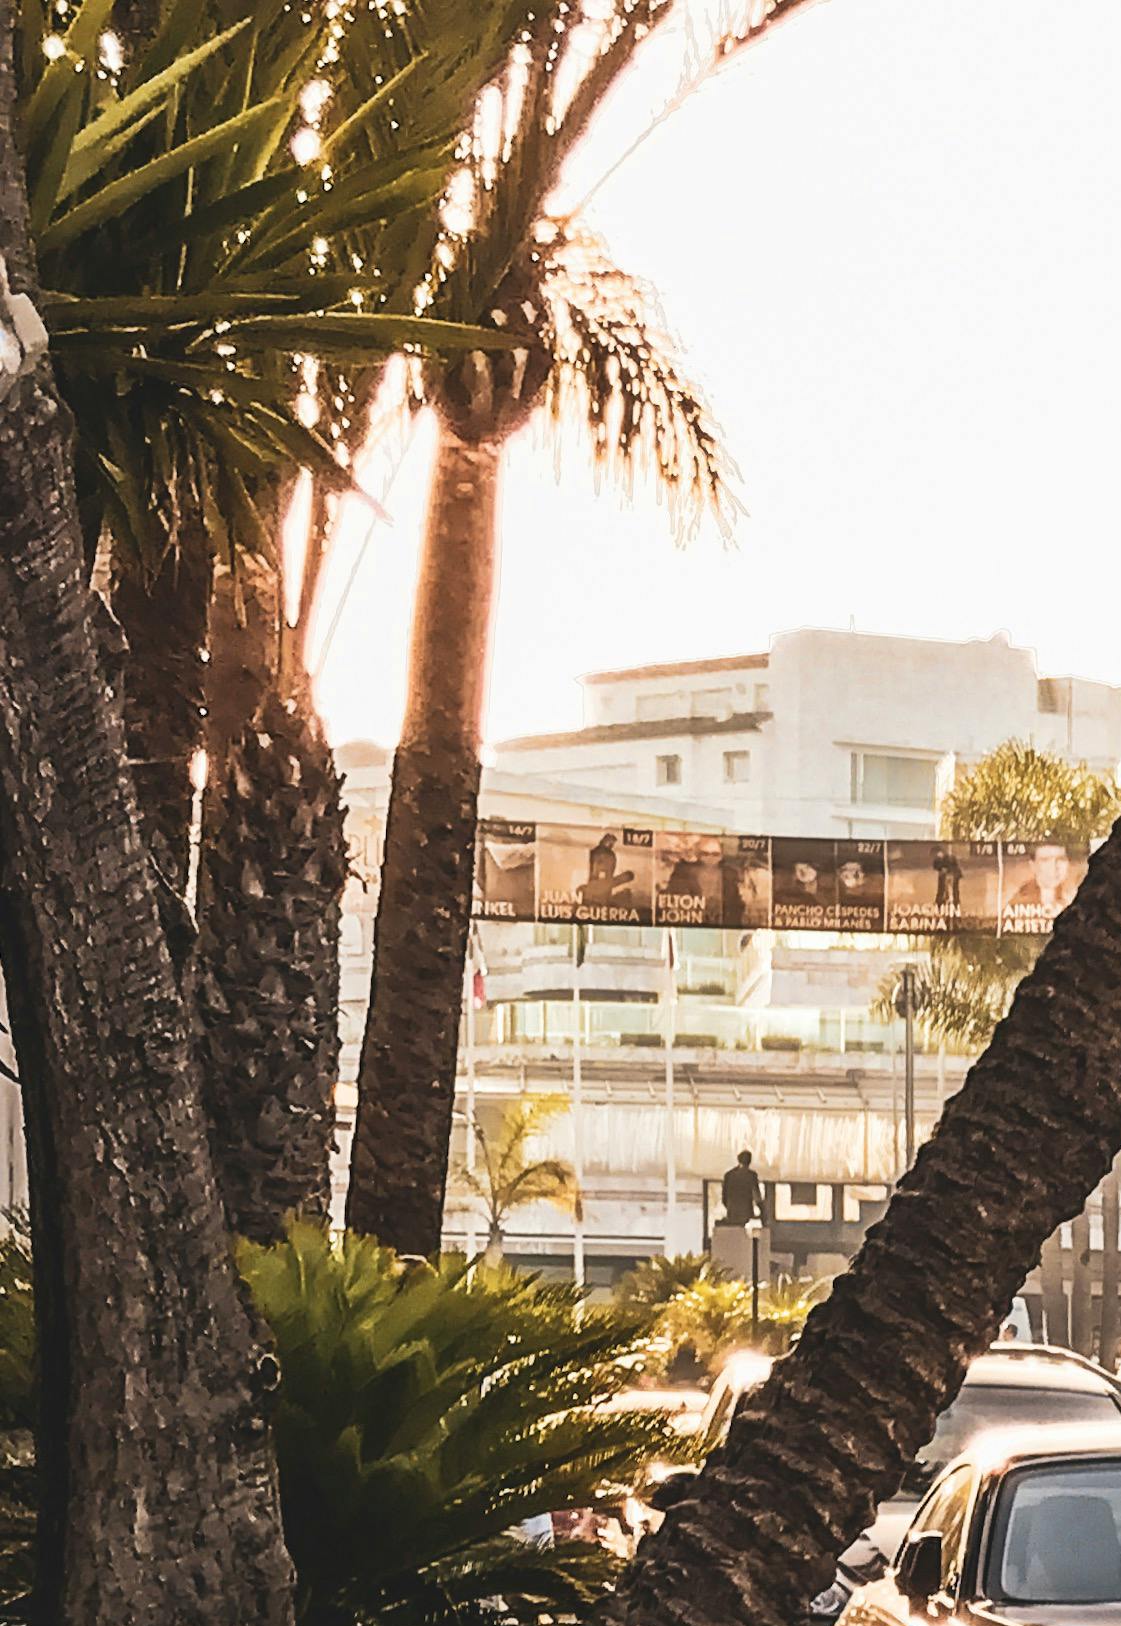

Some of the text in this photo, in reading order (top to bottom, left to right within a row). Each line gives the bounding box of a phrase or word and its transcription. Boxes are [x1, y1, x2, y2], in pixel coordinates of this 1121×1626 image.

[542, 890, 583, 904] JUAN
[659, 894, 706, 910] ELTON
[541, 904, 640, 922] LUIS GUERRA
[658, 909, 703, 924] JOHN
[774, 904, 823, 916] PANCHO
[785, 917, 821, 928] PABLO
[889, 917, 948, 931] SABINA
